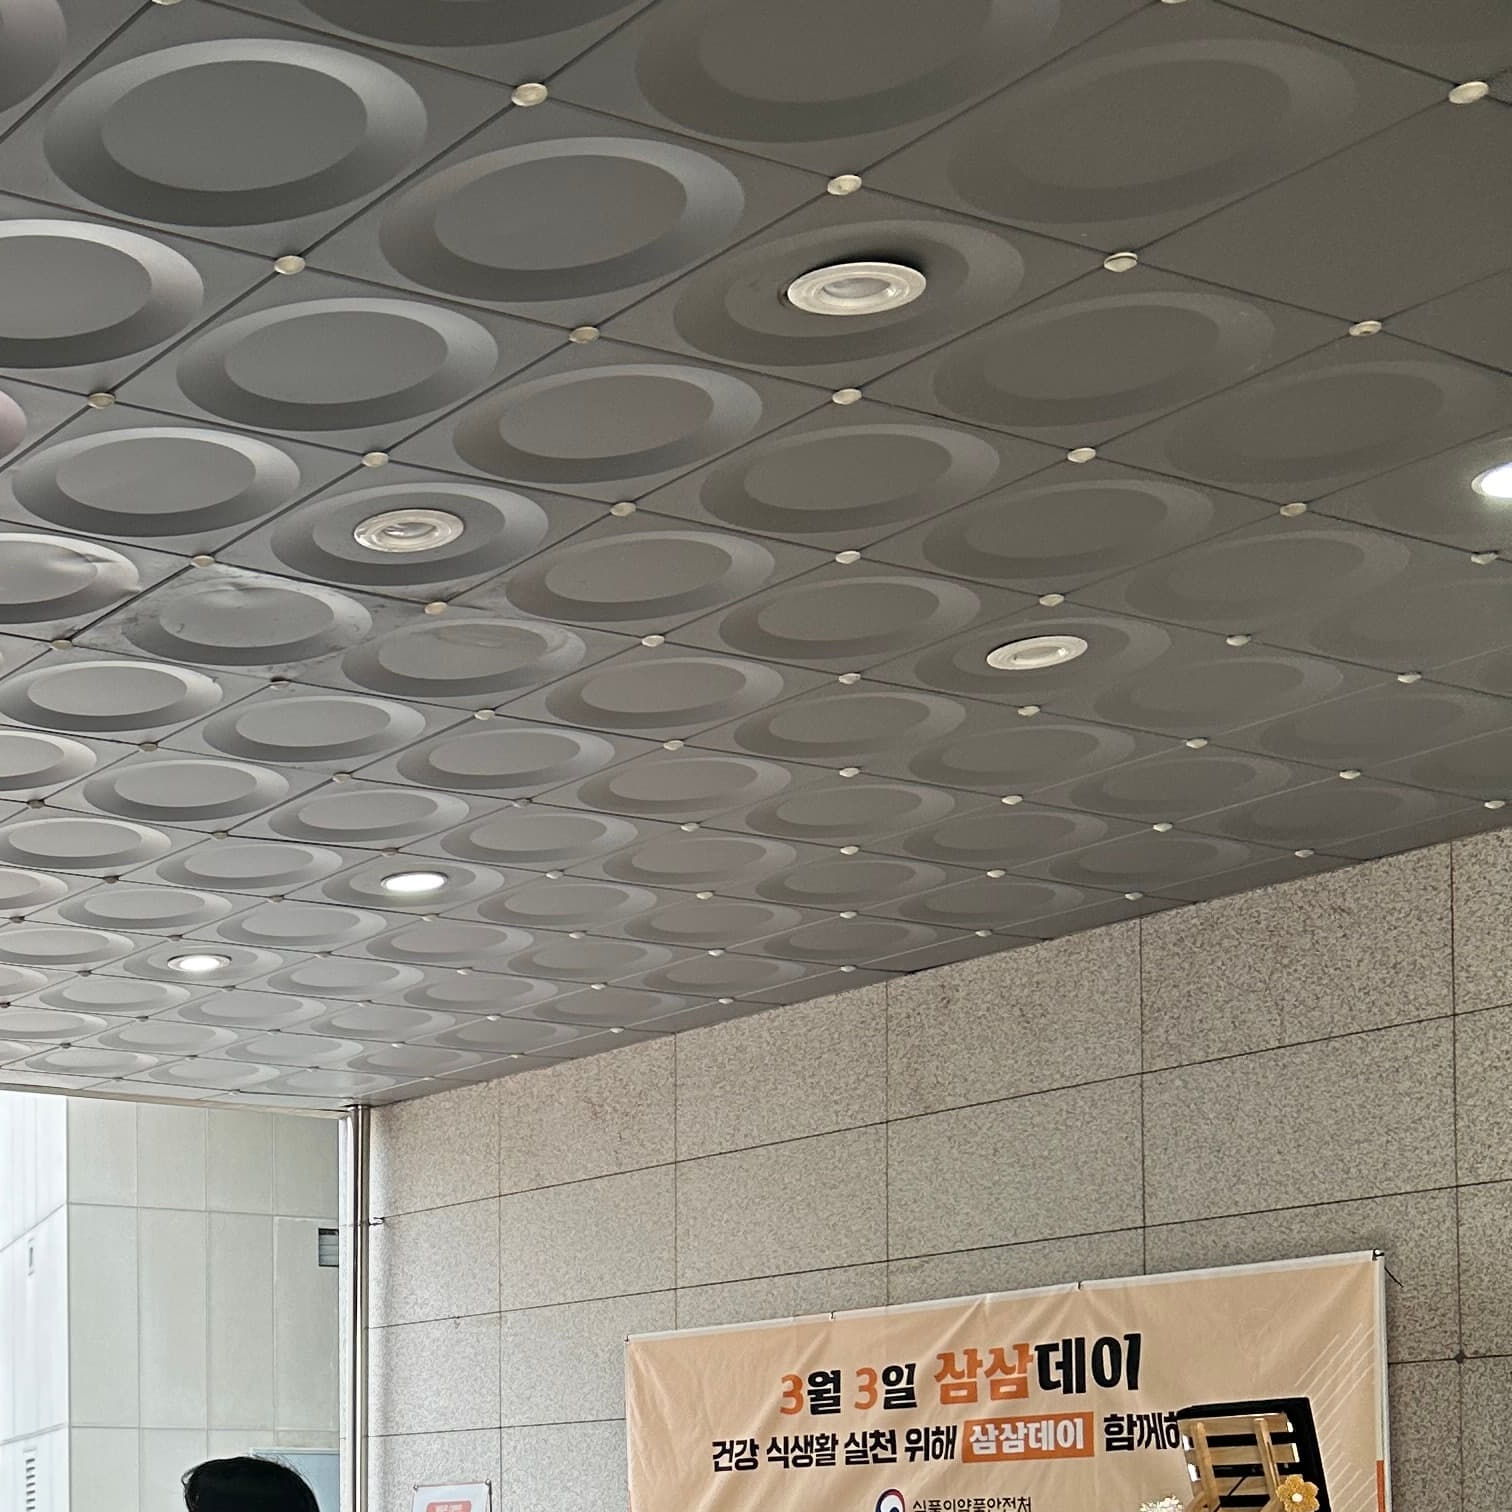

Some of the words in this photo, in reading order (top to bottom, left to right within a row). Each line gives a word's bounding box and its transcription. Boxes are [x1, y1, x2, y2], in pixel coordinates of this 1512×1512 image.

[779, 1369, 842, 1416] 3월
[854, 1363, 918, 1411] 3일
[934, 1333, 1142, 1405] 삼삼데이
[712, 1438, 760, 1473] 건강
[766, 1433, 839, 1469] 식생활
[844, 1429, 898, 1466] 실천
[904, 1424, 958, 1463] 위해
[969, 1417, 1084, 1456] 삼삼데이
